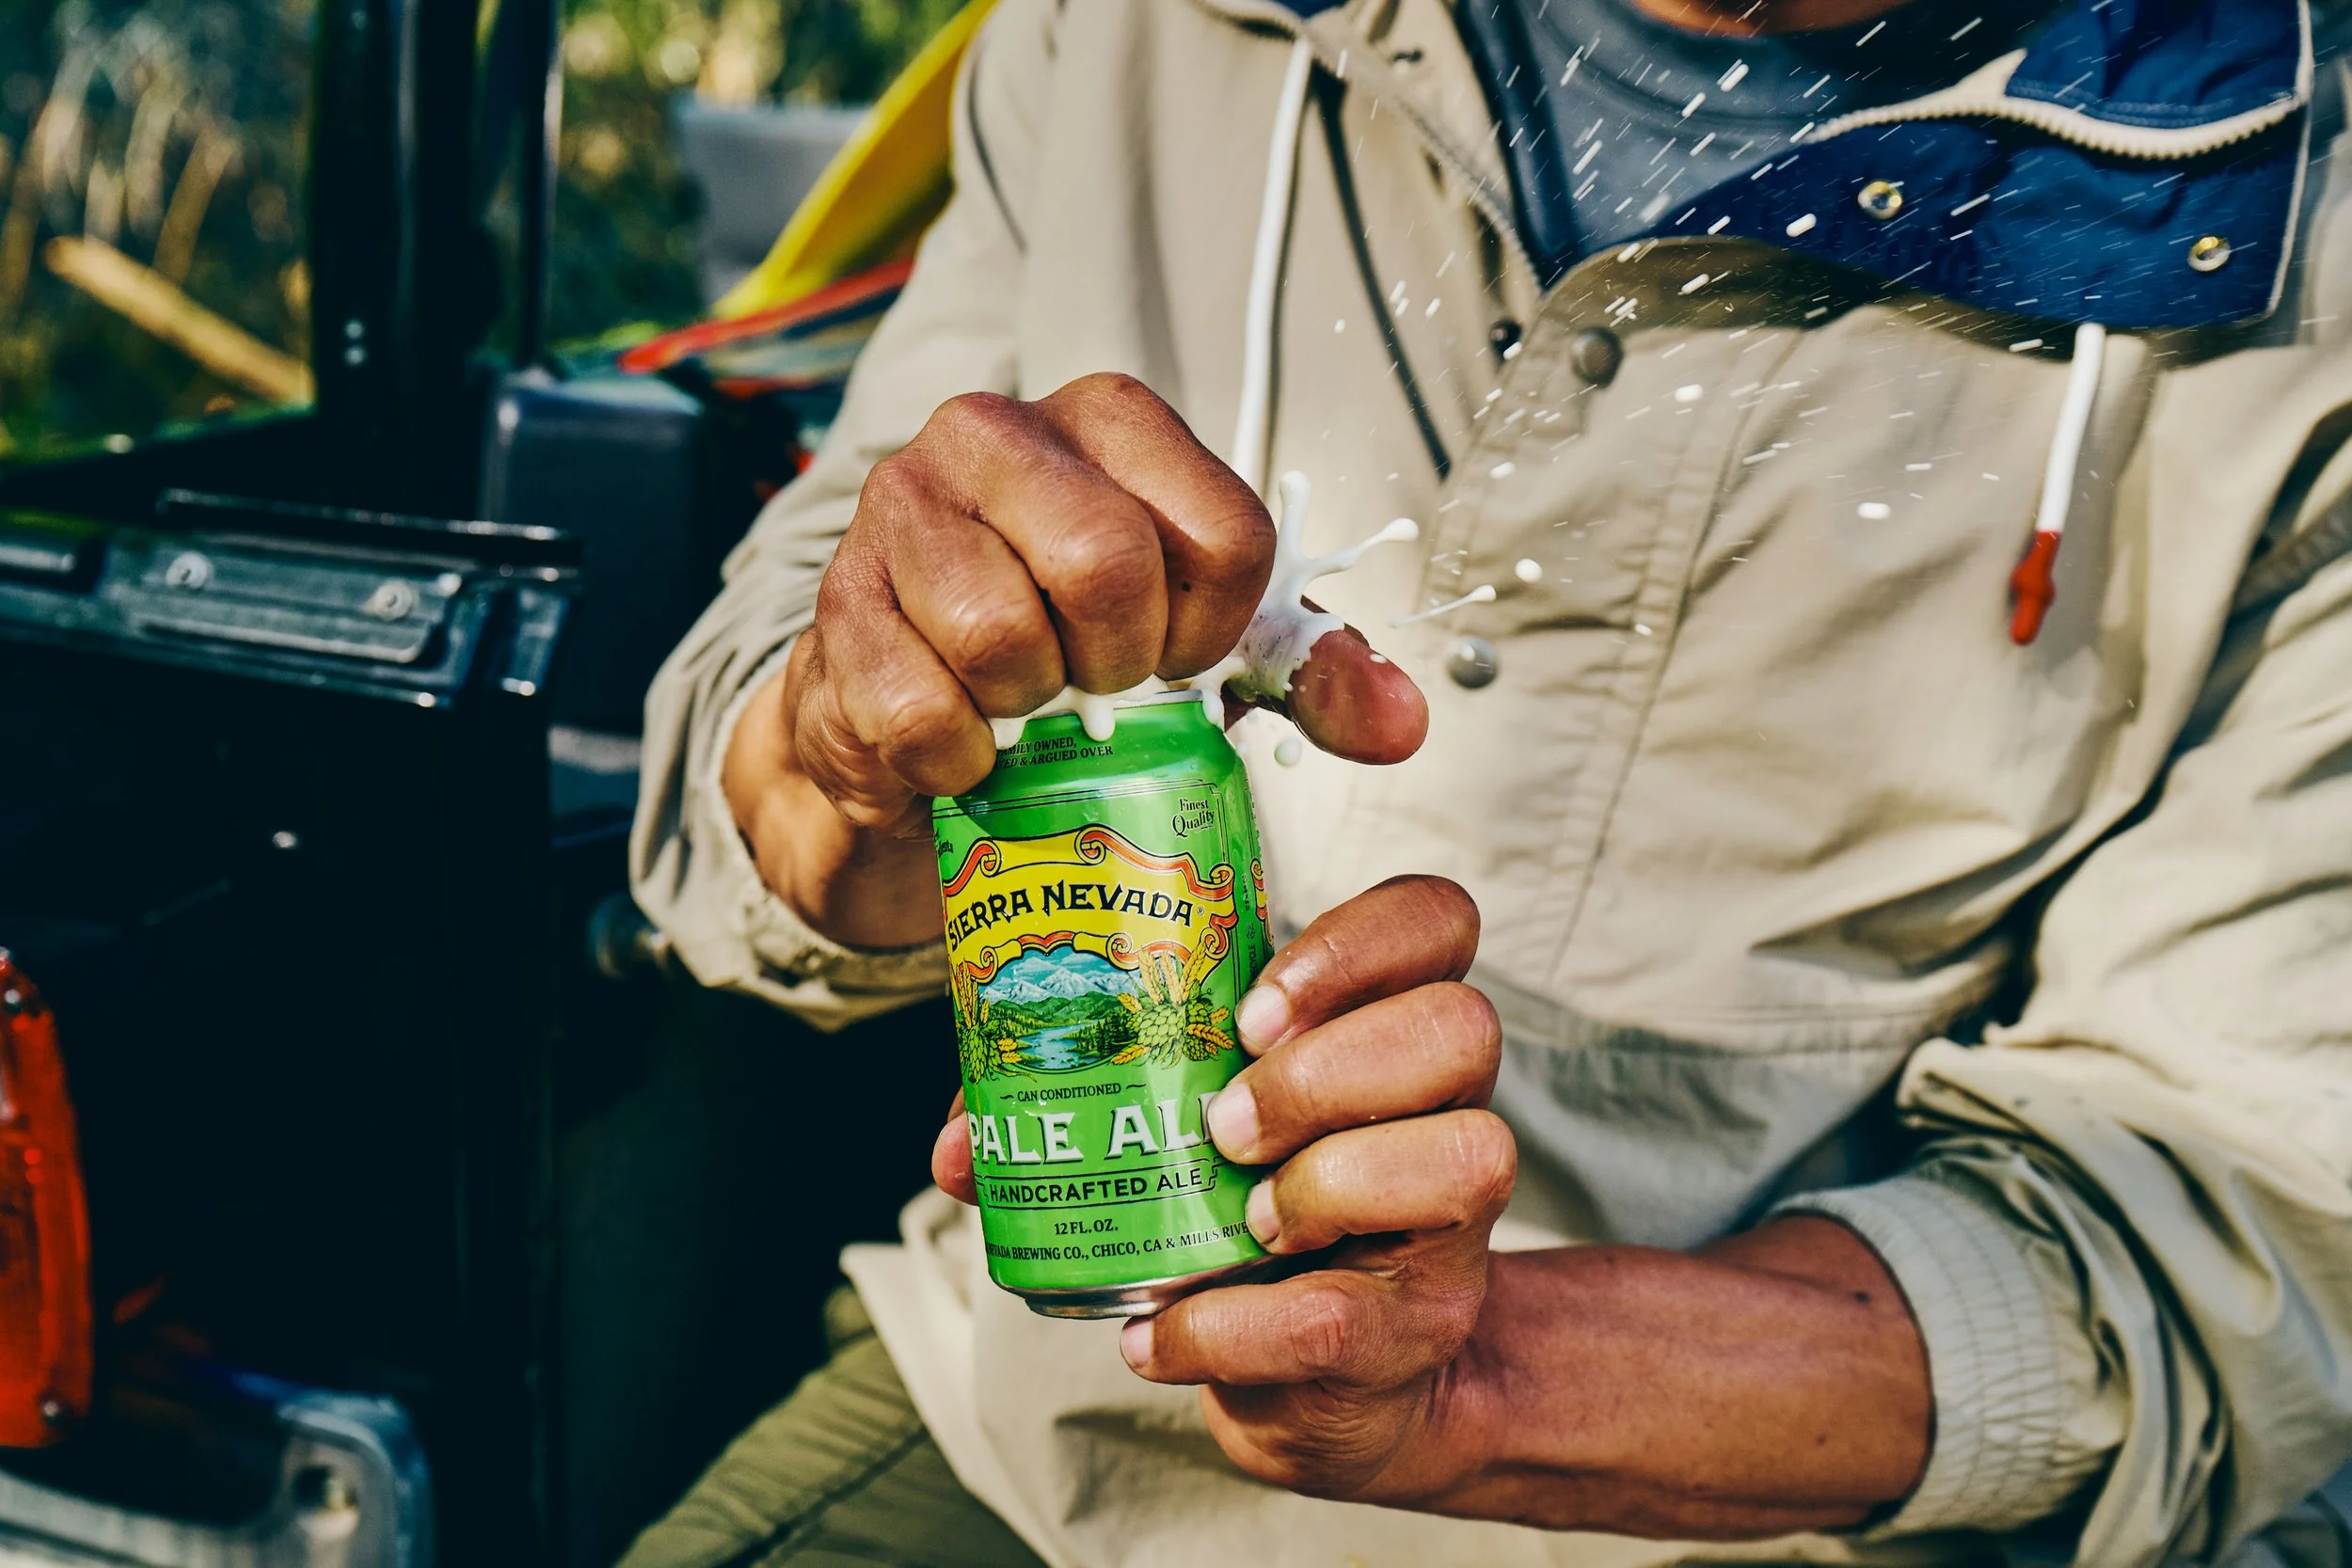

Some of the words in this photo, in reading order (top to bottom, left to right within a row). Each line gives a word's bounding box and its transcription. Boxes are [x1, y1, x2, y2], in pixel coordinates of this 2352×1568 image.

[996, 742, 1032, 756] MILY
[1033, 736, 1077, 752] OWNED,
[1029, 750, 1078, 766] ARGUED
[1080, 745, 1114, 758] OVER
[1179, 799, 1209, 812] Finest
[1172, 810, 1215, 838] Quality
[947, 889, 1036, 953] SIERRA
[1017, 1089, 1039, 1102] CAN
[1040, 1083, 1122, 1101] CONDITIONED
[967, 1111, 1085, 1166] PALE
[989, 1178, 1148, 1204] HANDCRAFTED
[1156, 1167, 1203, 1193] ALE
[1011, 1246, 1061, 1260] BREWING
[1063, 1245, 1089, 1260] CO.,
[1091, 1241, 1140, 1258] CHICO,
[1143, 1239, 1163, 1253] CA
[1166, 1236, 1176, 1249] &
[1180, 1228, 1220, 1247] MILLS
[1222, 1221, 1249, 1239] RIVE
